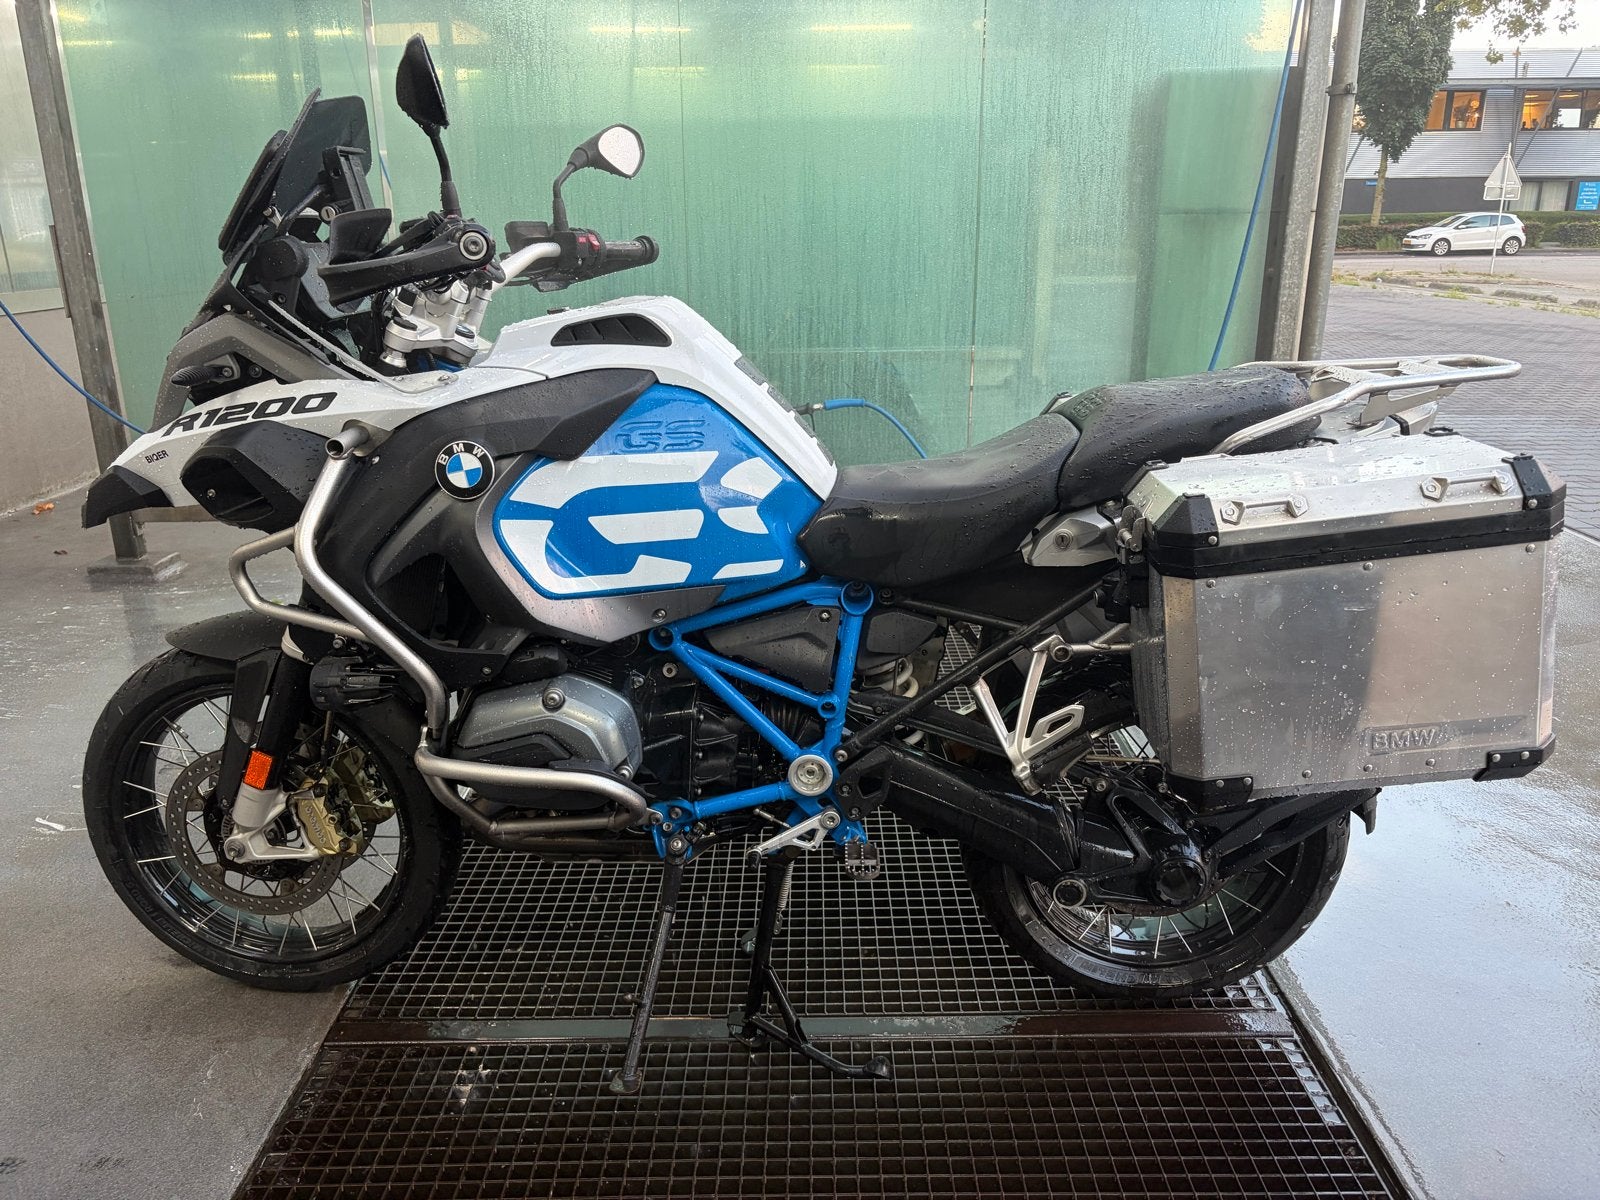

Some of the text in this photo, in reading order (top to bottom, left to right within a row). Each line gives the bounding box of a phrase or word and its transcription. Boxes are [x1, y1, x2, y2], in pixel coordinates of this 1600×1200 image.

[161, 392, 338, 438] R1200
[614, 419, 706, 453] GS
[438, 443, 485, 466] BMW
[1371, 728, 1436, 750] BMW
